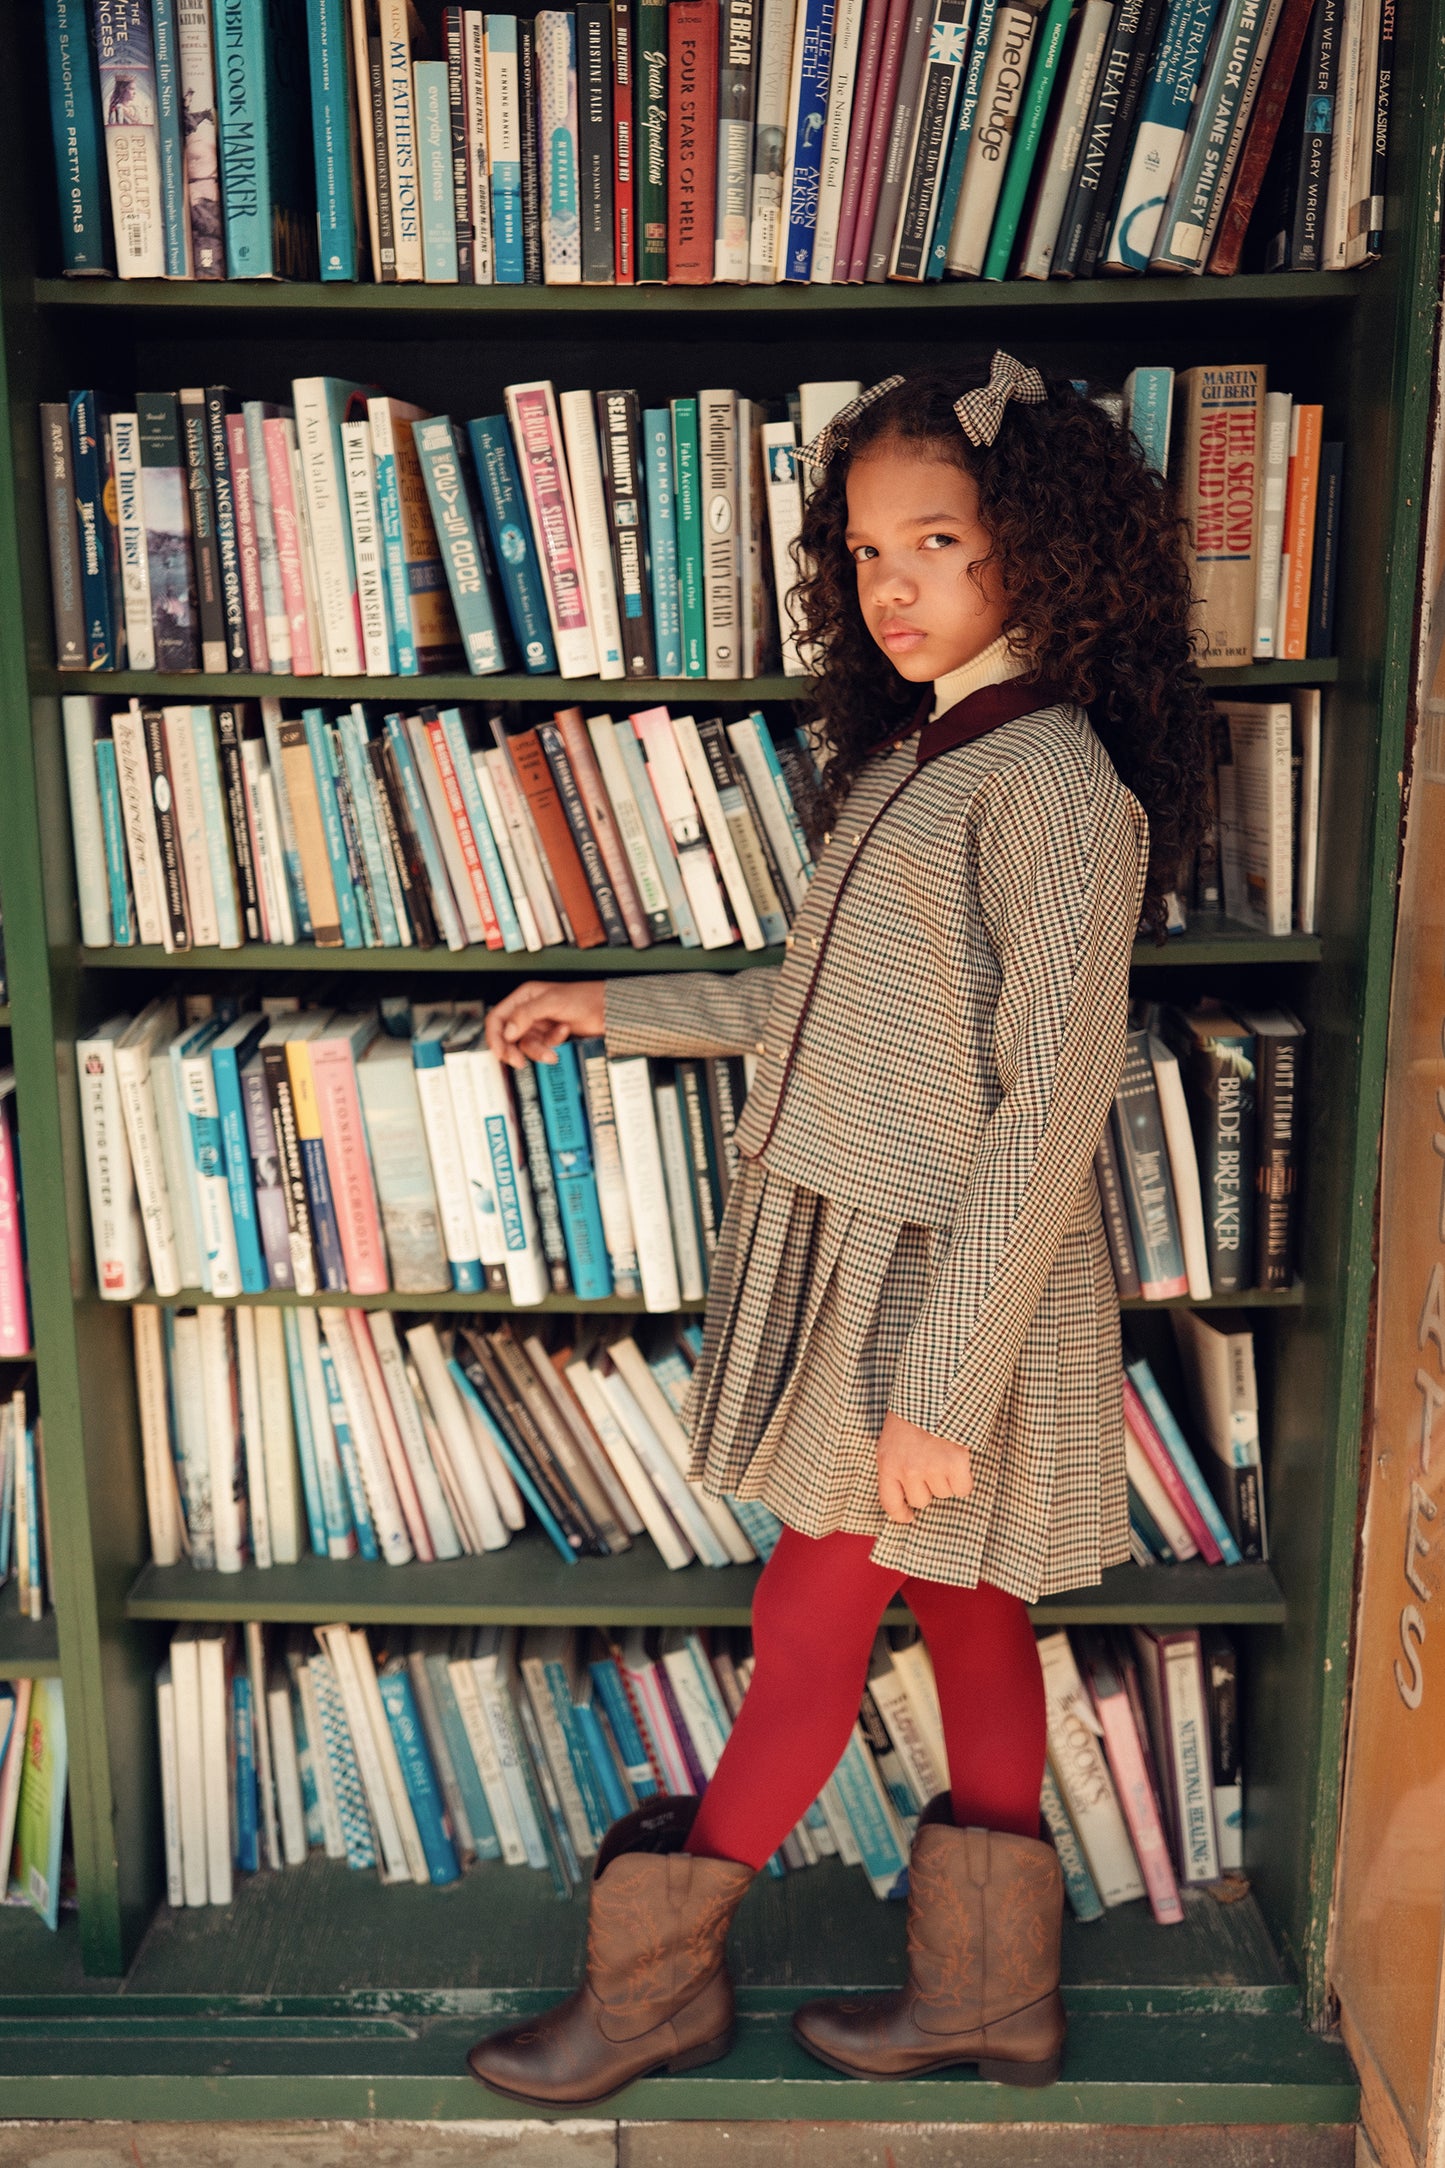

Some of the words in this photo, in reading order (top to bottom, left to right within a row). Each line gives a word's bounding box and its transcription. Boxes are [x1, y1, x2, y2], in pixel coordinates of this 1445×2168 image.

[131, 2, 139, 25] THE
[617, 28, 627, 46] HUGH
[819, 4, 834, 53] LITTLE
[1177, 11, 1192, 39] Times
[156, 19, 169, 60] Among
[389, 42, 407, 71] MY
[589, 21, 602, 83] CHRISTINE
[728, 17, 751, 65] BEAR
[802, 25, 820, 78] TEETH
[1004, 15, 1033, 64] The
[1044, 22, 1062, 69] NICKNAMES
[1171, 20, 1206, 106] FRANKEL
[1223, 35, 1250, 89] LUCK
[1317, 27, 1332, 90] WEAVER
[59, 35, 75, 118] SLAUGHTER
[160, 64, 171, 83] the
[228, 54, 247, 116] COOK
[321, 49, 330, 91] MAYHEM
[372, 64, 381, 90] HOW
[500, 67, 508, 107] HENNING
[617, 47, 628, 85] PENTECOST
[642, 50, 666, 100] Greater
[680, 40, 697, 94] FOUR
[814, 55, 830, 103] TINY
[837, 73, 848, 100] The
[966, 50, 985, 95] Record
[1099, 48, 1130, 115] HEAT
[1165, 68, 1178, 85] Life
[1237, 57, 1264, 119] DADDY'S
[1378, 70, 1391, 106] ISAAC
[162, 86, 174, 116] Stars
[373, 94, 382, 107] TO
[427, 86, 442, 146] everyday
[590, 89, 603, 123] FALLS
[935, 75, 952, 111] Gone
[959, 98, 977, 131] Book
[978, 67, 1021, 162] Grudge
[374, 110, 384, 139] COOK
[391, 79, 413, 167] FATHER'S
[502, 112, 510, 150] MANKELL
[618, 121, 628, 159] CANCELLED
[679, 101, 696, 162] STARS
[829, 103, 844, 152] National
[929, 113, 945, 145] with
[1208, 93, 1234, 146] JANE
[1374, 108, 1387, 156] ASIMOV
[67, 127, 80, 183] PRETTY
[377, 142, 387, 189] CHICKEN
[641, 105, 666, 186] Expectations
[727, 124, 748, 183] DARWIN'S
[925, 149, 939, 172] the
[1079, 121, 1114, 190] WAVE
[1308, 138, 1323, 178] GARY
[223, 122, 258, 221] MARKER
[431, 151, 445, 201] tidiness
[557, 141, 568, 203] MURAKAMI
[593, 155, 601, 200] BENJAMIN
[679, 168, 695, 195] OF
[826, 156, 838, 189] Road
[1188, 149, 1220, 223] SMILEY
[71, 188, 83, 233] GIRLS
[380, 192, 391, 238] BREASTS
[398, 175, 417, 242] HOUSE
[504, 186, 513, 210] FIFTH
[593, 203, 601, 232] BLACK
[790, 166, 806, 225] ELKINS
[804, 165, 820, 229] AARON
[913, 176, 936, 240] Windsors
[1304, 183, 1318, 241] WRIGHT
[504, 214, 514, 244] WOMAN
[679, 200, 694, 246] HELL
[1202, 384, 1258, 400] GILBERT
[1203, 369, 1258, 386] MARTIN
[305, 416, 320, 446] Am
[522, 405, 550, 464] JERICHO'S
[606, 396, 627, 432] SEAN
[1229, 410, 1256, 457] THE
[116, 421, 134, 463] FIRST
[186, 418, 206, 467] STATES
[348, 438, 363, 462] WIL
[481, 433, 492, 449] the
[680, 442, 692, 468] Fake
[706, 403, 733, 490] Redemption
[1199, 412, 1228, 498] WORLD
[309, 452, 330, 510] Malala
[485, 452, 506, 520] Cheesemakers
[494, 446, 510, 482] Blessed
[502, 485, 514, 503] Are
[534, 466, 554, 495] FALL
[610, 435, 632, 495] HANNITY
[655, 432, 670, 519] COMMON
[1302, 476, 1310, 494] The
[118, 470, 138, 521] THINGS
[352, 491, 372, 544] HYLTON
[681, 471, 693, 521] Accounts
[1226, 461, 1255, 553] SECOND
[1300, 496, 1309, 529] Natural
[214, 478, 235, 568] ANCESTRAL
[541, 506, 568, 554] STEPHEN
[1196, 502, 1224, 552] WAR
[84, 523, 99, 576] PERISHING
[124, 526, 139, 568] FIRST
[666, 540, 674, 556] LET
[710, 540, 731, 579] NANCY
[658, 567, 666, 594] LAST
[668, 567, 676, 592] LOVE
[686, 557, 696, 585] Lauren
[224, 572, 241, 626] GRACE
[361, 570, 382, 639] VANISHED
[554, 572, 580, 618] CARTER
[670, 603, 679, 634] HAVE
[686, 586, 696, 610] Oyler
[712, 585, 734, 629] GEARY
[659, 602, 669, 636] WORD
[707, 739, 724, 759] THE
[553, 753, 578, 797] THOMAS
[566, 801, 587, 829] SWAN
[713, 762, 731, 785] LOST
[1274, 1045, 1294, 1089] SCOTT
[92, 1082, 105, 1114] THE
[714, 1061, 736, 1135] JENNIFER
[1218, 1077, 1240, 1144] BLADE
[1273, 1094, 1293, 1141] TUROW
[95, 1120, 109, 1148] FIG
[486, 1117, 515, 1186] RONALD
[97, 1154, 113, 1207] EATER
[1104, 1168, 1114, 1188] ON
[1212, 1150, 1240, 1252] BREAKER
[1108, 1192, 1120, 1214] THE
[1114, 1218, 1132, 1275] GALLOWS
[1268, 1203, 1288, 1256] ERRORS
[1063, 1713, 1112, 1806] COOK'S
[1181, 1720, 1202, 1804] NUTRITIONAL
[1188, 1806, 1209, 1864] HEALING
